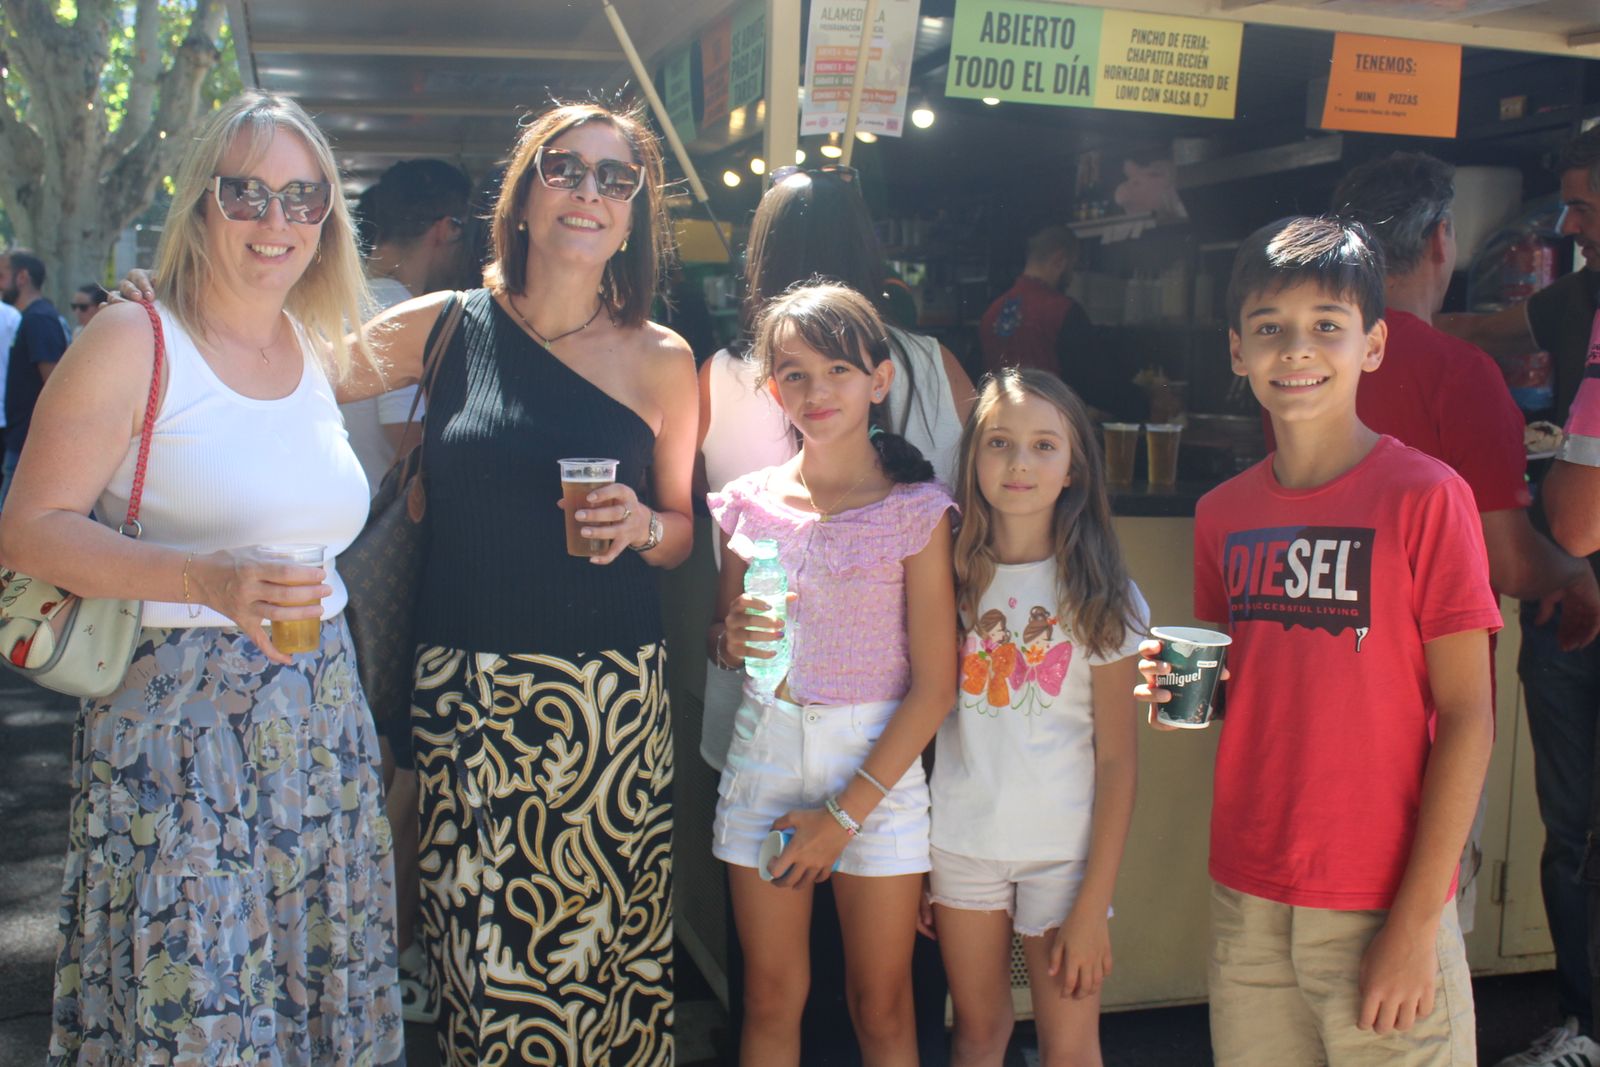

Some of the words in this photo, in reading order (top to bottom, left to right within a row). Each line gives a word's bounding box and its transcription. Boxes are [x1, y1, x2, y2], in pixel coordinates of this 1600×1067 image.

[980, 11, 1075, 49] ABIERTO
[1131, 29, 1165, 46] PINCHO
[1167, 32, 1181, 48] DE
[1181, 34, 1210, 50] FERIA:
[1127, 48, 1174, 65] CHAPATITA
[1356, 54, 1417, 73] TENEMOS:
[955, 55, 1015, 90] TODO
[1022, 61, 1044, 92] EL
[1053, 55, 1089, 95] DÍA
[1104, 65, 1150, 81] HORNEADA
[1152, 69, 1165, 84] DE
[1167, 71, 1214, 89] CABECERO
[1216, 76, 1230, 91] DE
[1116, 85, 1139, 100] LOMO
[1141, 87, 1161, 102] CON
[1162, 89, 1192, 106] SALSA
[1355, 92, 1376, 102] MINI
[1388, 93, 1418, 105] PIZZAS
[1228, 538, 1358, 601] DIESEL
[1316, 607, 1360, 617] LIVING
